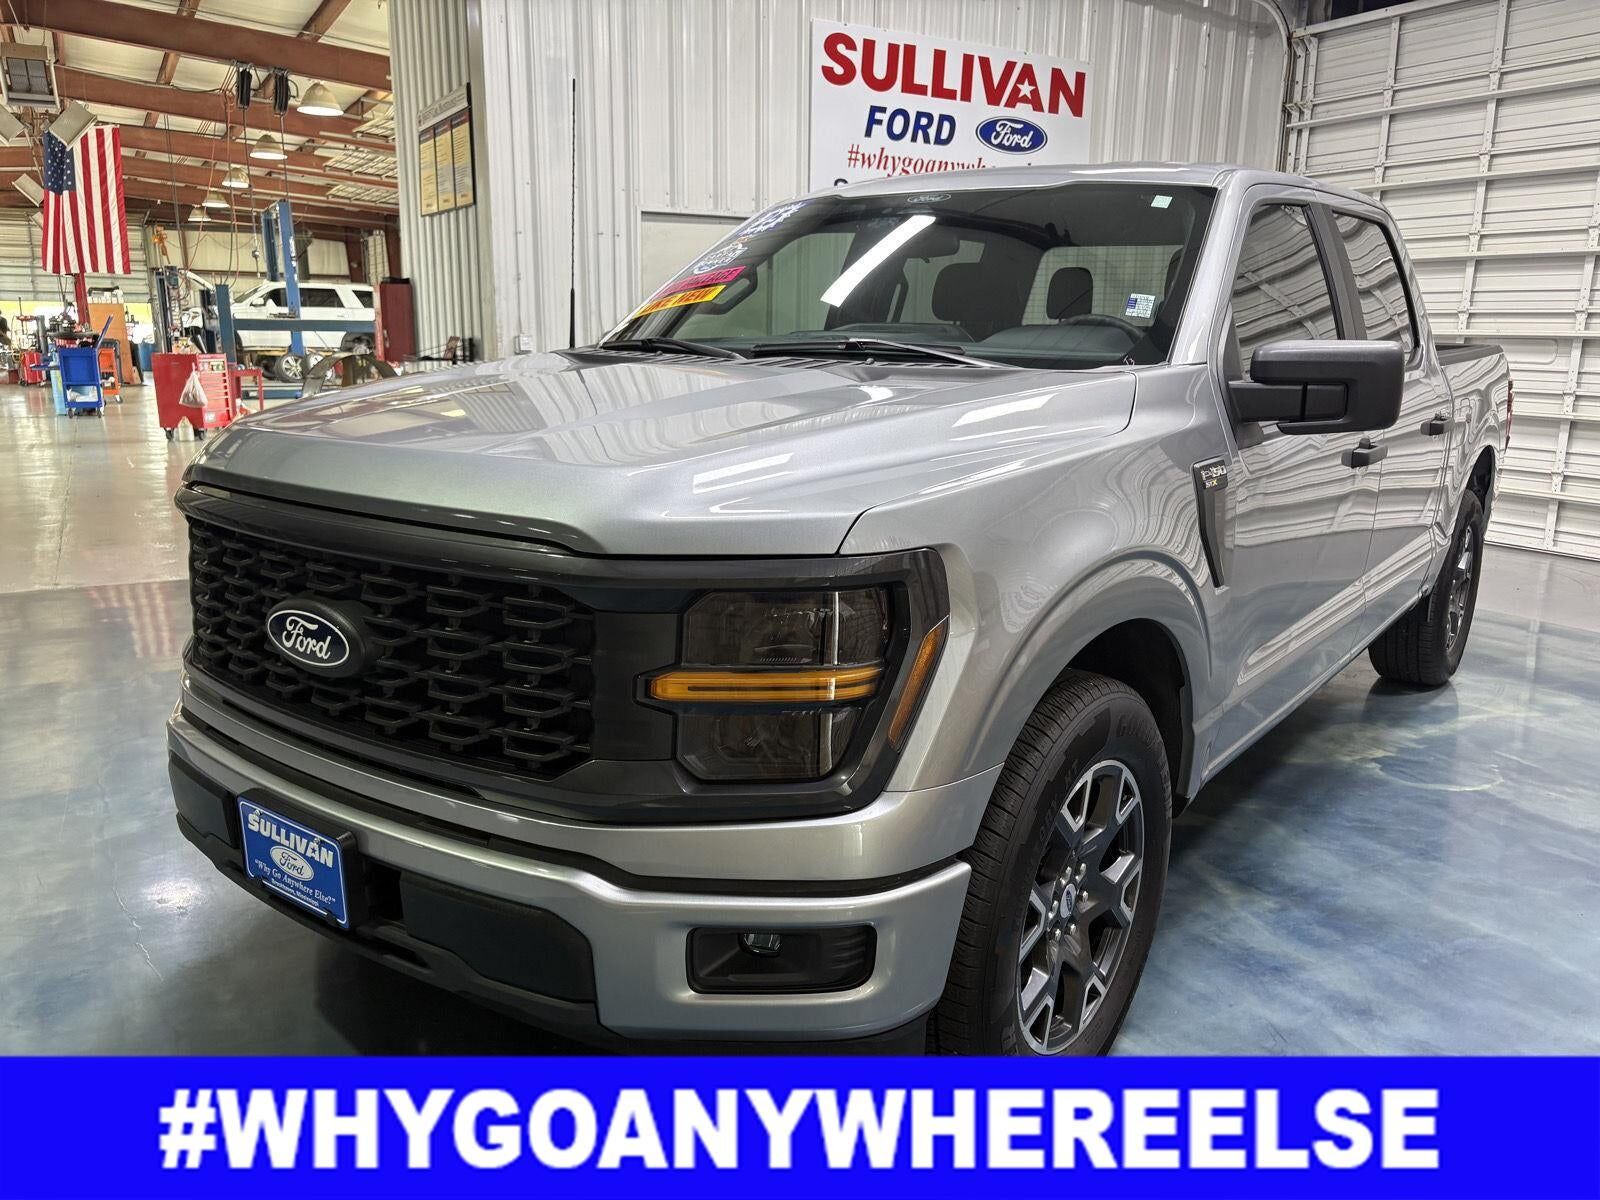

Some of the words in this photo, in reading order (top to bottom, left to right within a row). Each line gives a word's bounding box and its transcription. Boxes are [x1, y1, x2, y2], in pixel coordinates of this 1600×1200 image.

[821, 32, 1086, 117] SULLIVAN
[864, 105, 956, 146] FORD
[991, 120, 1034, 148] Ford
[282, 616, 331, 659] Ford
[248, 812, 333, 868] SULLIVAN
[272, 869, 281, 878] Go
[282, 874, 313, 895] Anywhere
[280, 851, 304, 876] Ford
